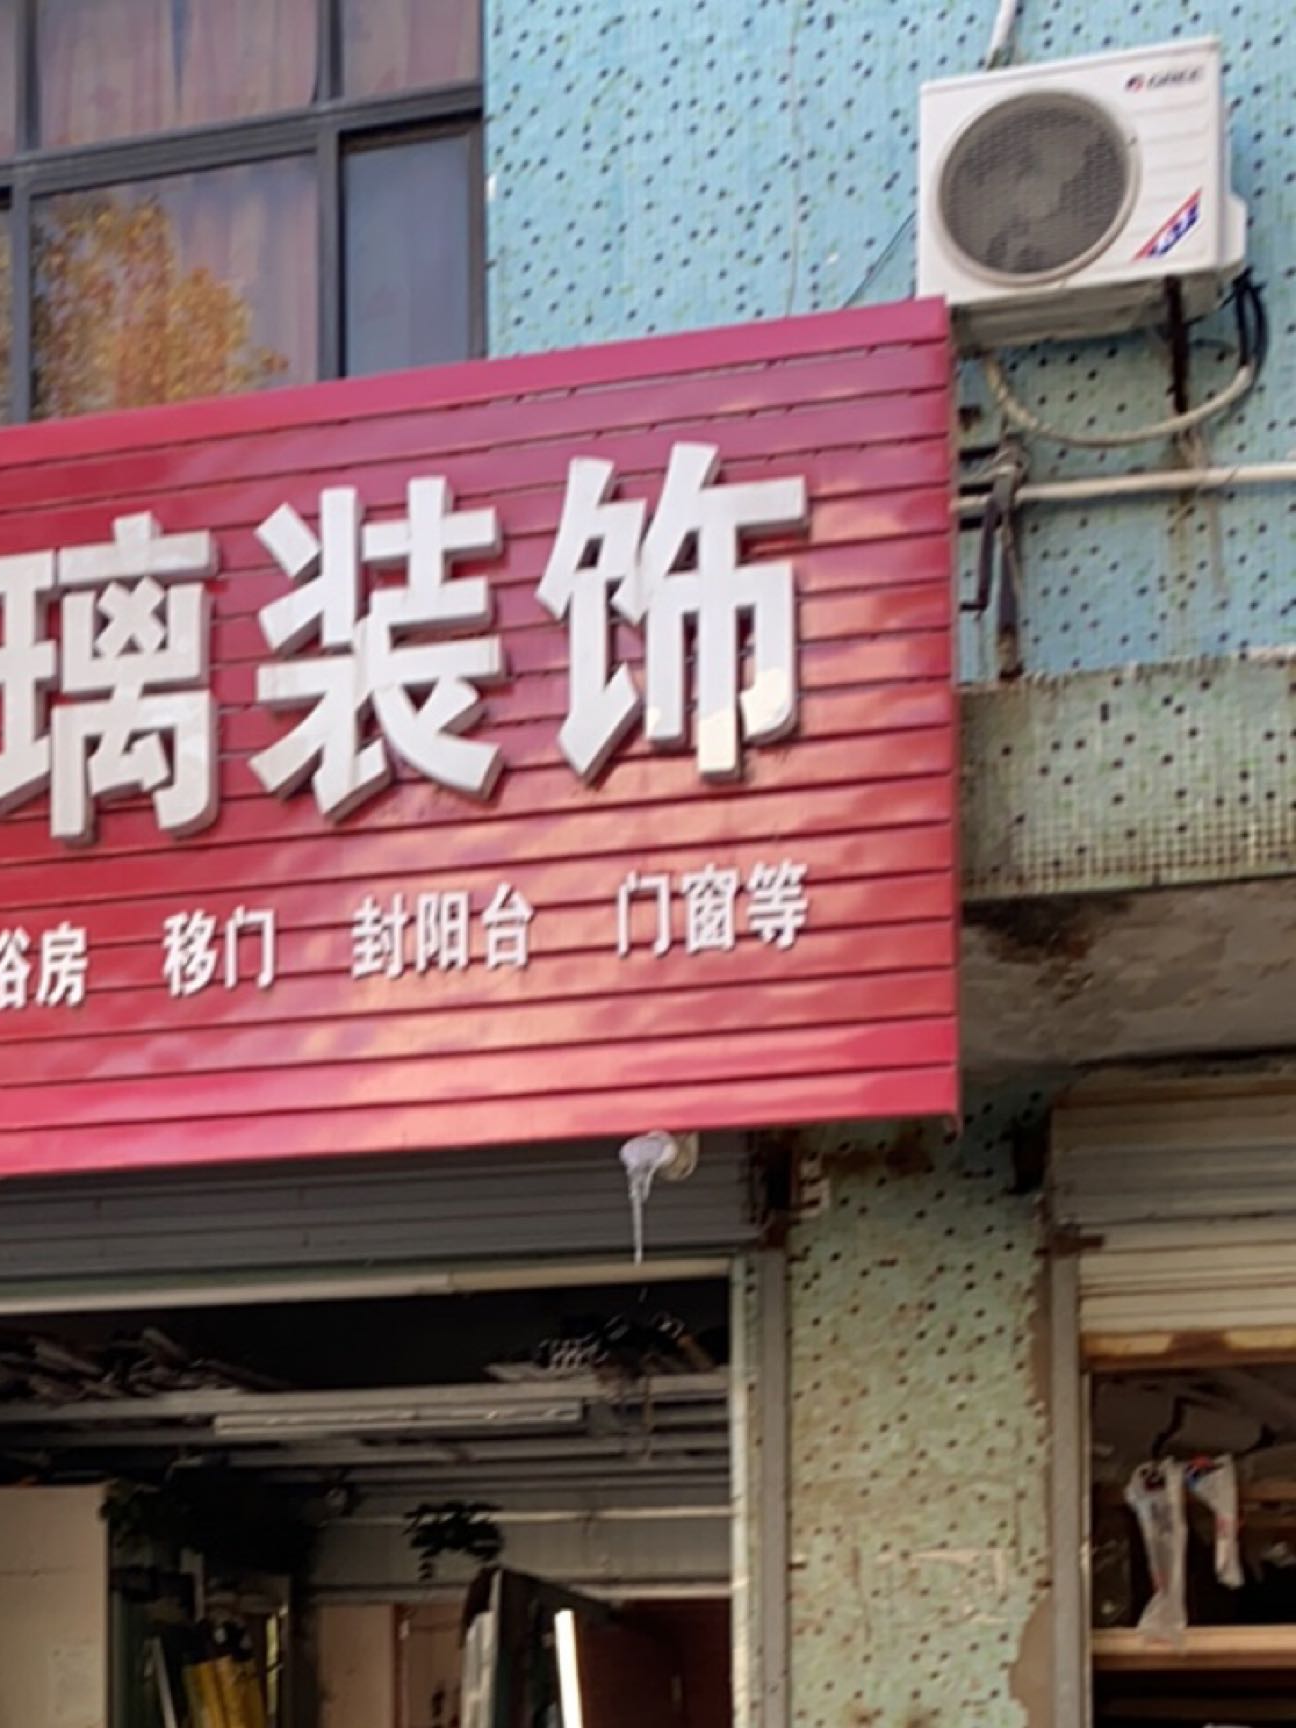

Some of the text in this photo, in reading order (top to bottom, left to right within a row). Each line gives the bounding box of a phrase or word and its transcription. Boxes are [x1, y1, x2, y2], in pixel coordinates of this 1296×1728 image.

[161, 905, 277, 997] 移门
[350, 882, 536, 980] 封阳台
[615, 859, 811, 957] 门窗等
